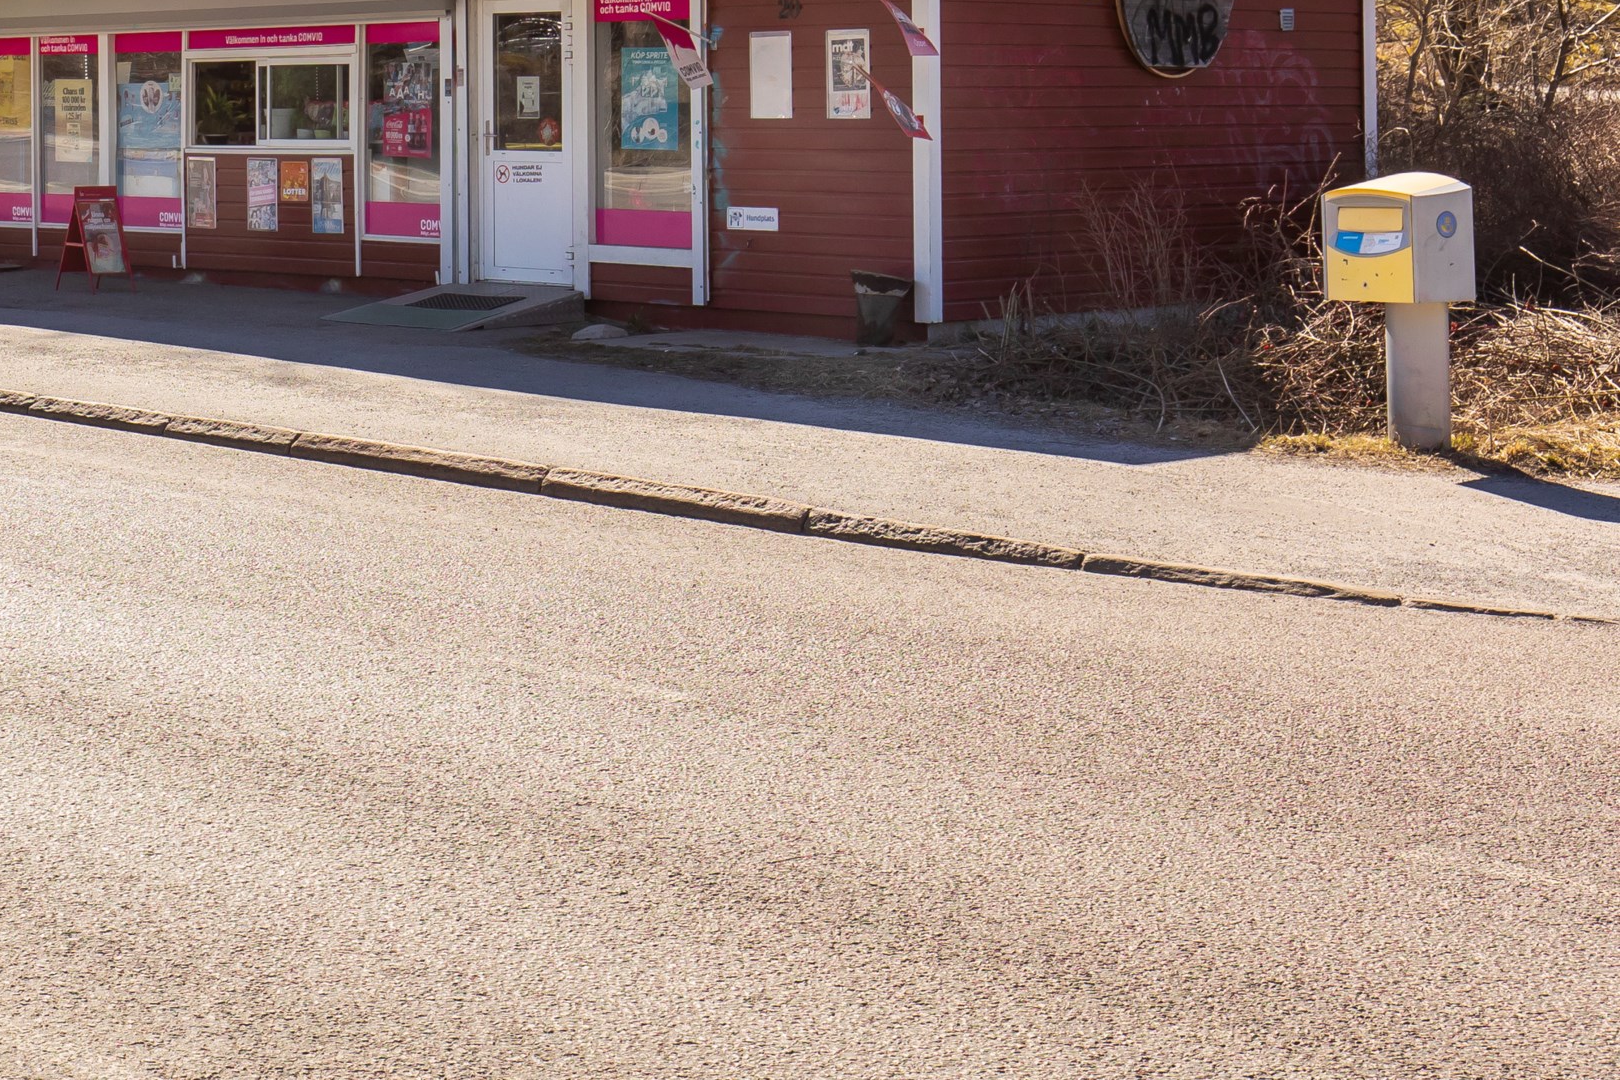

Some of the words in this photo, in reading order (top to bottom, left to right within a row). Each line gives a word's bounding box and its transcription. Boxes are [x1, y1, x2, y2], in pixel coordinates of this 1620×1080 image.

[599, 5, 614, 14] och
[615, 3, 639, 13] tanka
[640, 1, 671, 12] COMVIQ
[40, 36, 69, 44] Välkommen
[225, 35, 259, 45] Välkommen
[260, 35, 266, 43] in
[267, 34, 278, 43] och
[279, 33, 298, 42] tanka
[298, 32, 323, 42] COMVIQ
[40, 44, 50, 52] och
[51, 44, 67, 52] tanka
[68, 43, 88, 52] COMVIQ
[631, 51, 644, 59] KÖP
[646, 51, 668, 59] SPRITE
[680, 62, 704, 77] COMVIQ
[283, 187, 306, 195] LOTTER
[12, 206, 32, 216] COMVI
[159, 212, 182, 222] COMVI
[746, 214, 775, 222] Hundplats
[420, 219, 440, 230] COM
